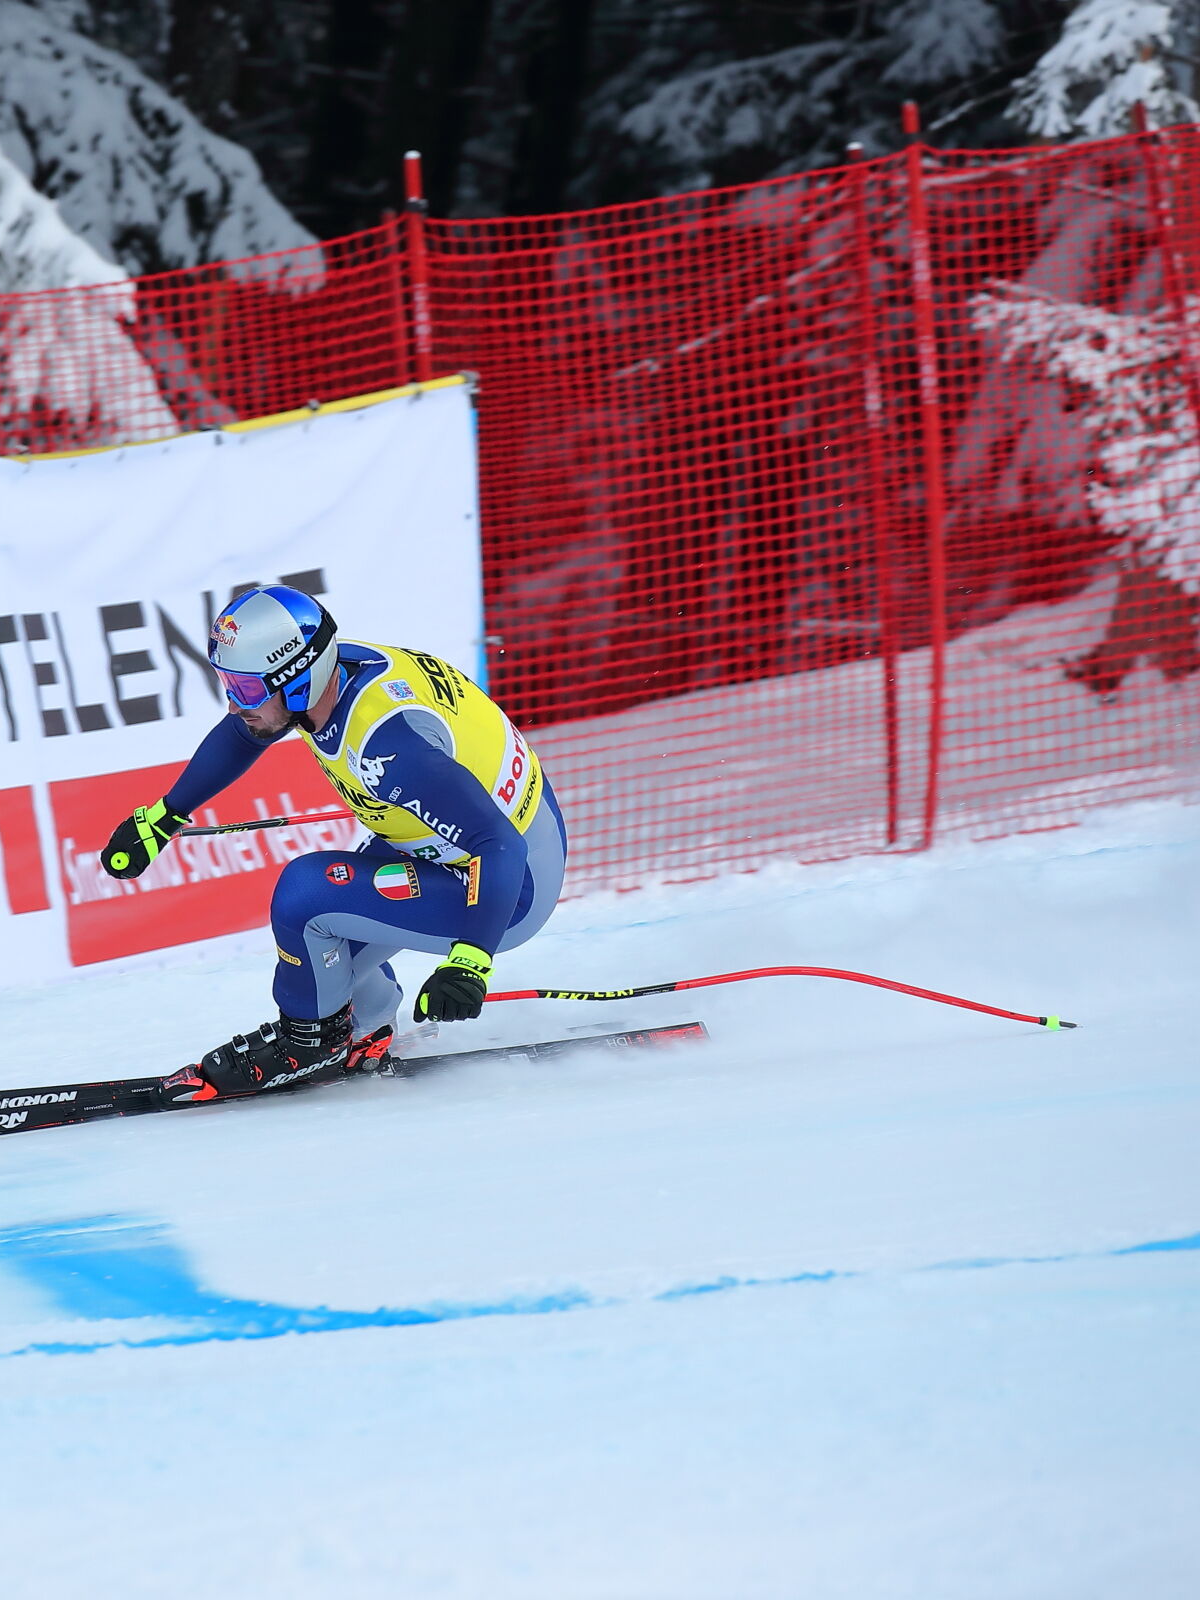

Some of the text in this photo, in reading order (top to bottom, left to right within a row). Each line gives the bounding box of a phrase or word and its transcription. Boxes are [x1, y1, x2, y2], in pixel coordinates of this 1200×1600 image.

[266, 636, 302, 664] uvex
[271, 646, 318, 687] uvex
[402, 799, 463, 843] Audi
[338, 865, 349, 881] RTL
[404, 863, 418, 895] ITALIA
[262, 1048, 349, 1089] NORDICA
